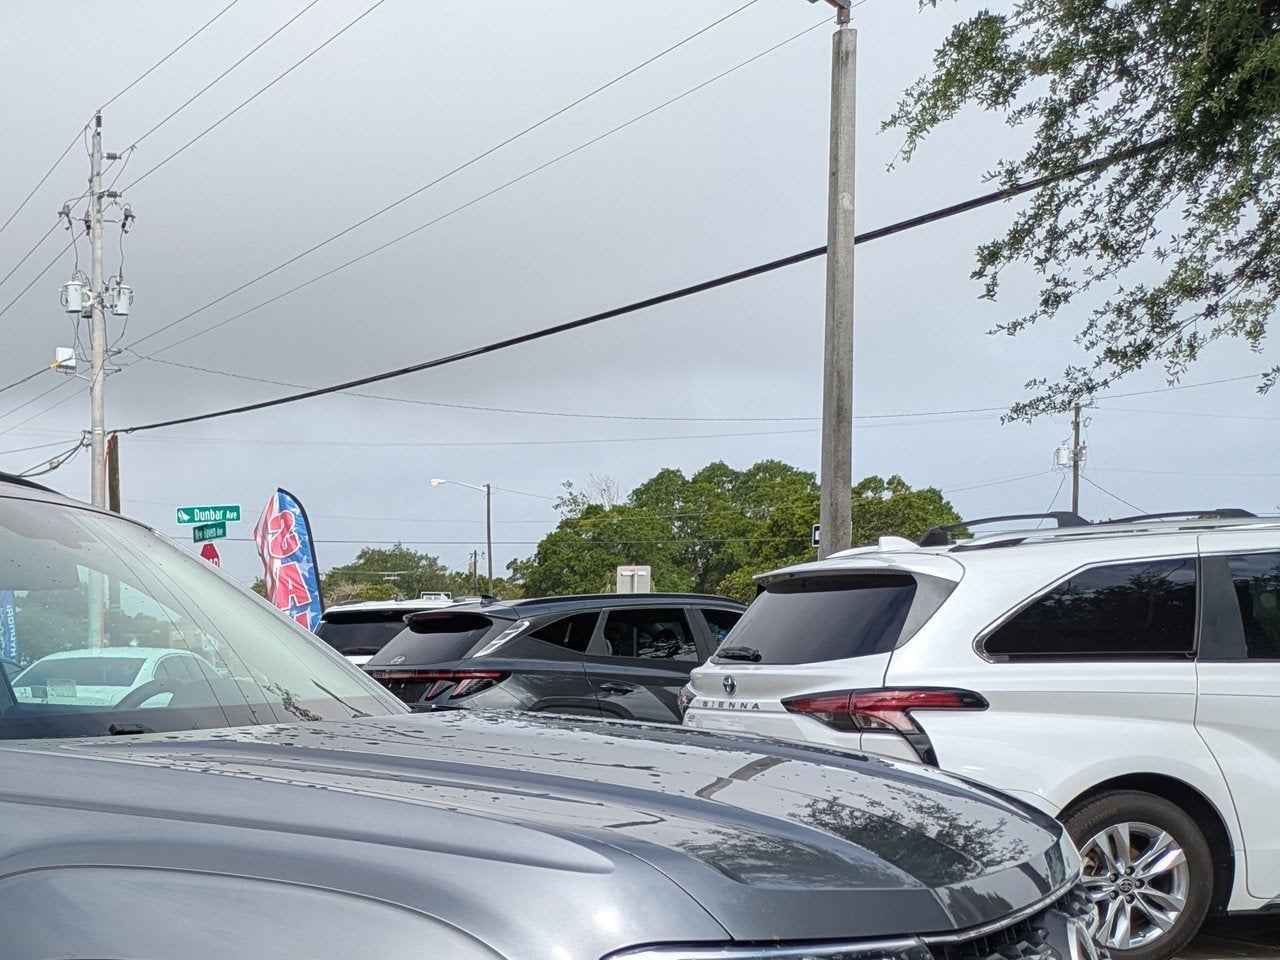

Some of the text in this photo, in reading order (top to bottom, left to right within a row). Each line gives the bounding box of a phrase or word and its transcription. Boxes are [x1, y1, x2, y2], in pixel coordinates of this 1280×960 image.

[194, 509, 238, 521] Dunbar Ave
[702, 700, 760, 710] SIENNA
